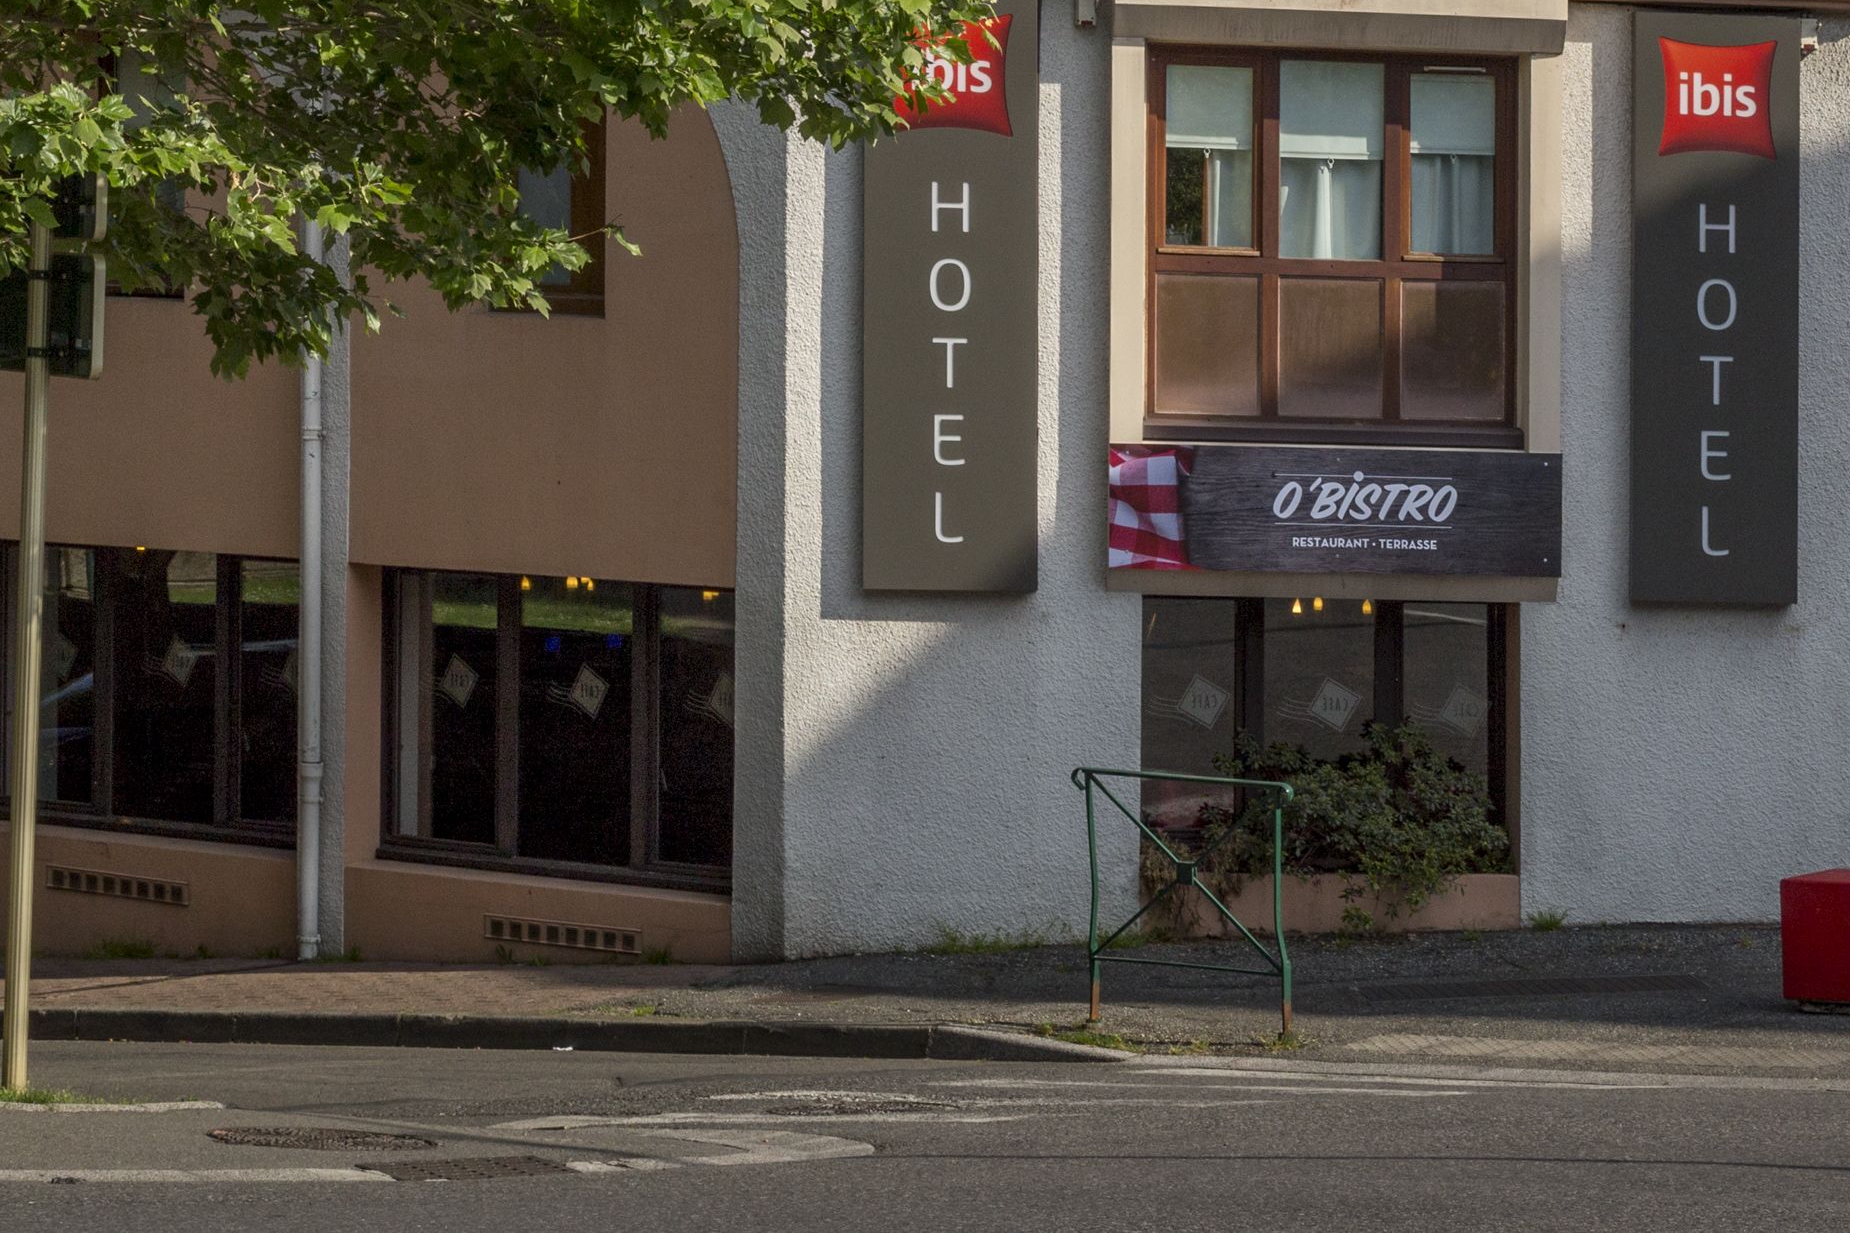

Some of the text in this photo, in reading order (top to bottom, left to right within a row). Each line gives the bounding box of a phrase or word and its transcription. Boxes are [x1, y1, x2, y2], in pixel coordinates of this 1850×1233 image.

[1679, 72, 1758, 118] ibis
[929, 181, 971, 543] HOTEL
[1696, 203, 1738, 557] HOTEL
[1292, 537, 1438, 551] RESTAURANT TERRASSE
